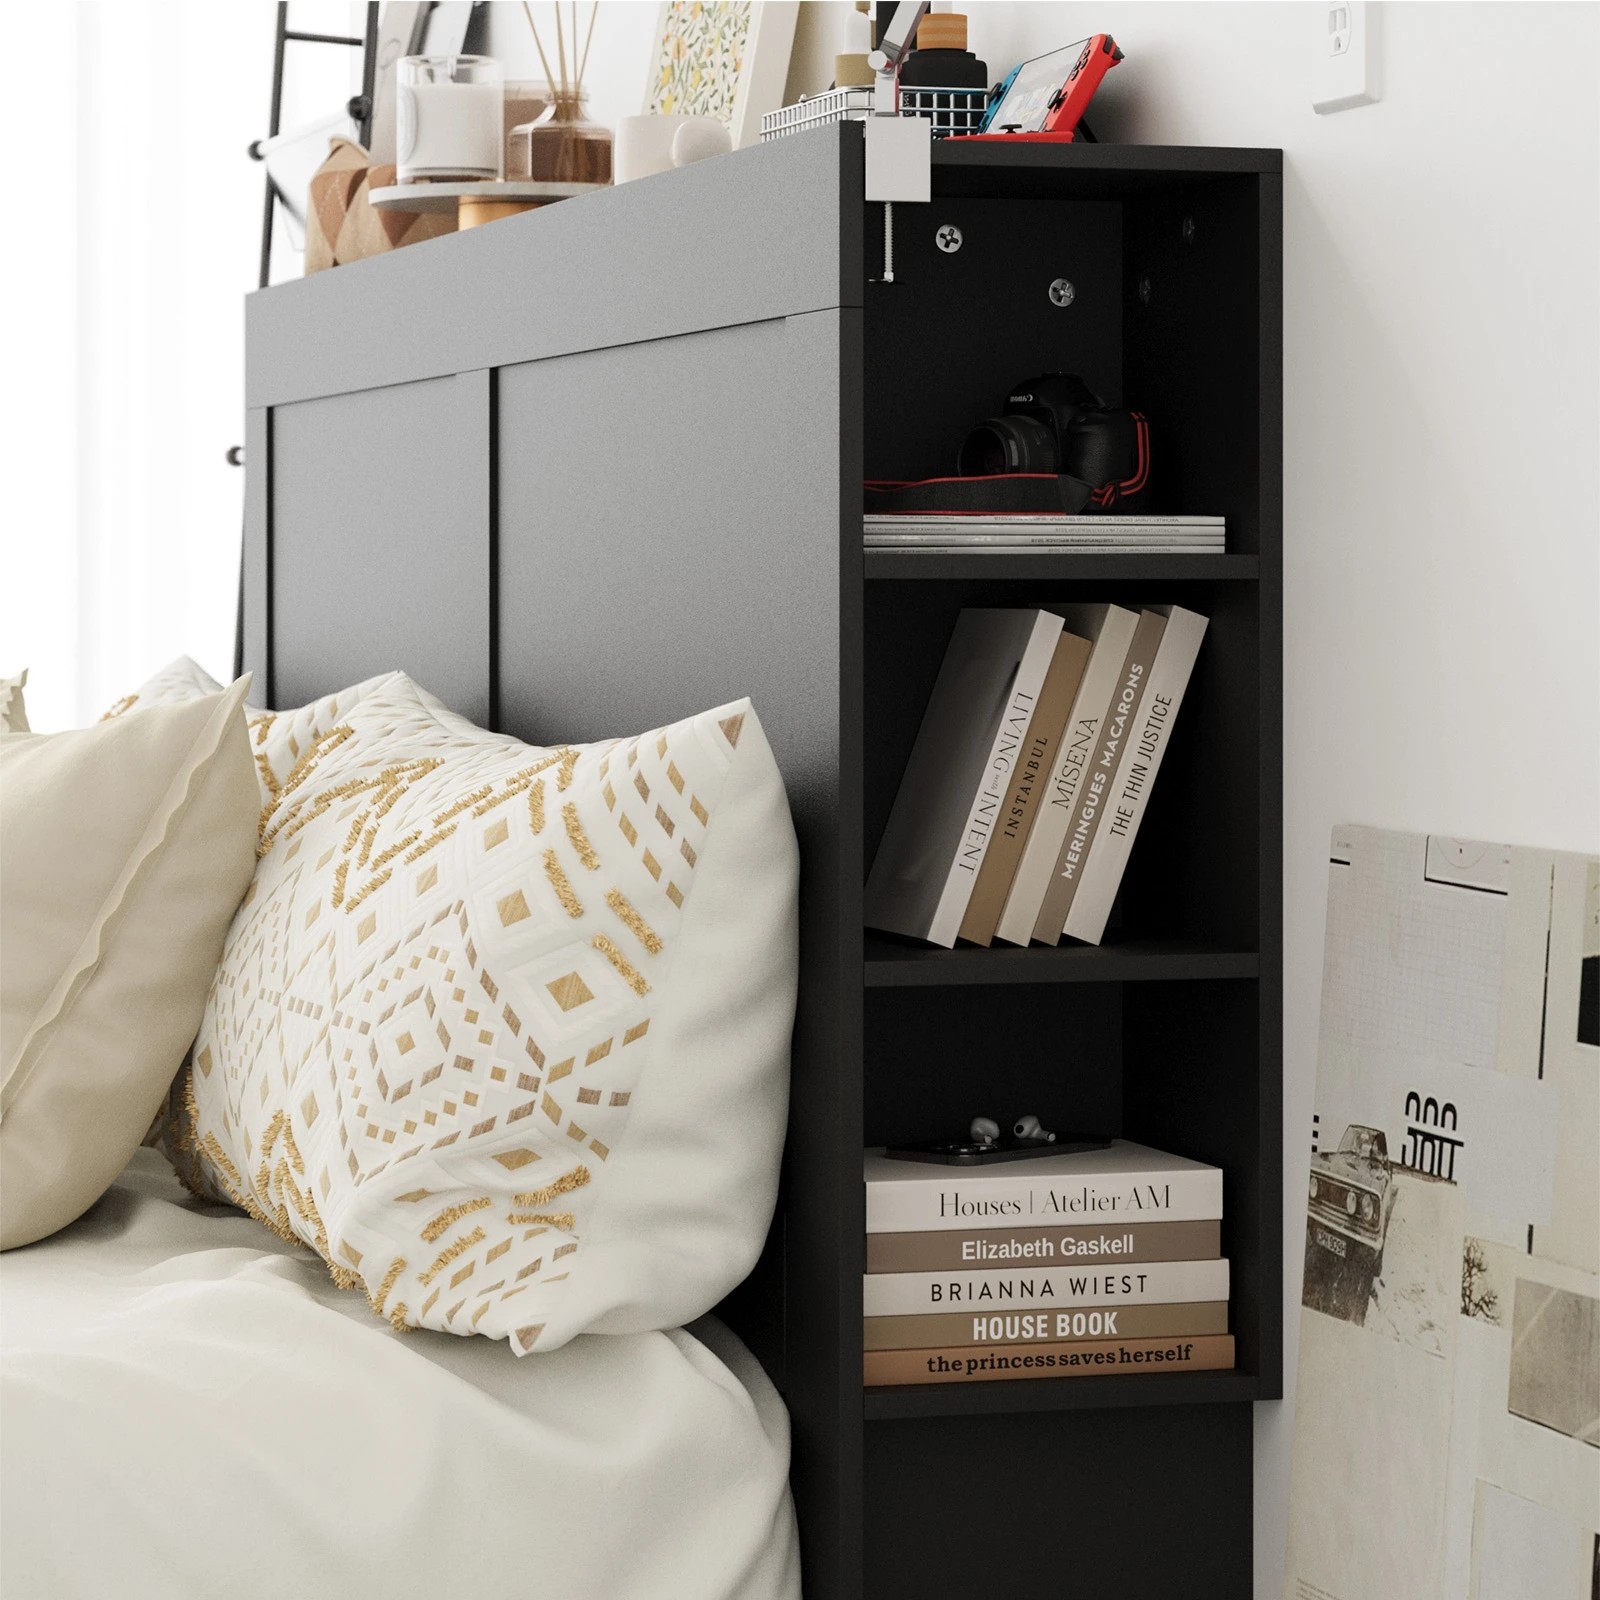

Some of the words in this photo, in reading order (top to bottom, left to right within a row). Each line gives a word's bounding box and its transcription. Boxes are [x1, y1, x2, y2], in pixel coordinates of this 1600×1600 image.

[992, 691, 1034, 774] LIVING
[1051, 717, 1099, 810] MÍSENA
[1060, 772, 1108, 880] MERINGUES
[1100, 663, 1144, 767] MACARONS
[1109, 805, 1134, 838] THE
[1122, 762, 1149, 804] THIN
[1137, 693, 1173, 762] JUSTICE
[1003, 736, 1049, 838] INSTANBUL
[957, 791, 998, 876] INTENT
[938, 1192, 1022, 1219] Houses
[1040, 1187, 1121, 1214] Atelier
[1124, 1184, 1172, 1210] AM
[930, 1279, 1055, 1303] BRIANNA
[1068, 1274, 1148, 1296] WIEST
[961, 1239, 1055, 1261] Elizabeth
[1060, 1234, 1134, 1256] Gaskell
[927, 1355, 962, 1373] the
[965, 1353, 1056, 1375] princess
[1058, 1351, 1116, 1367] saves
[1118, 1345, 1193, 1365] herself
[972, 1315, 1049, 1340] HOUSE
[1055, 1311, 1118, 1338] BOOK
